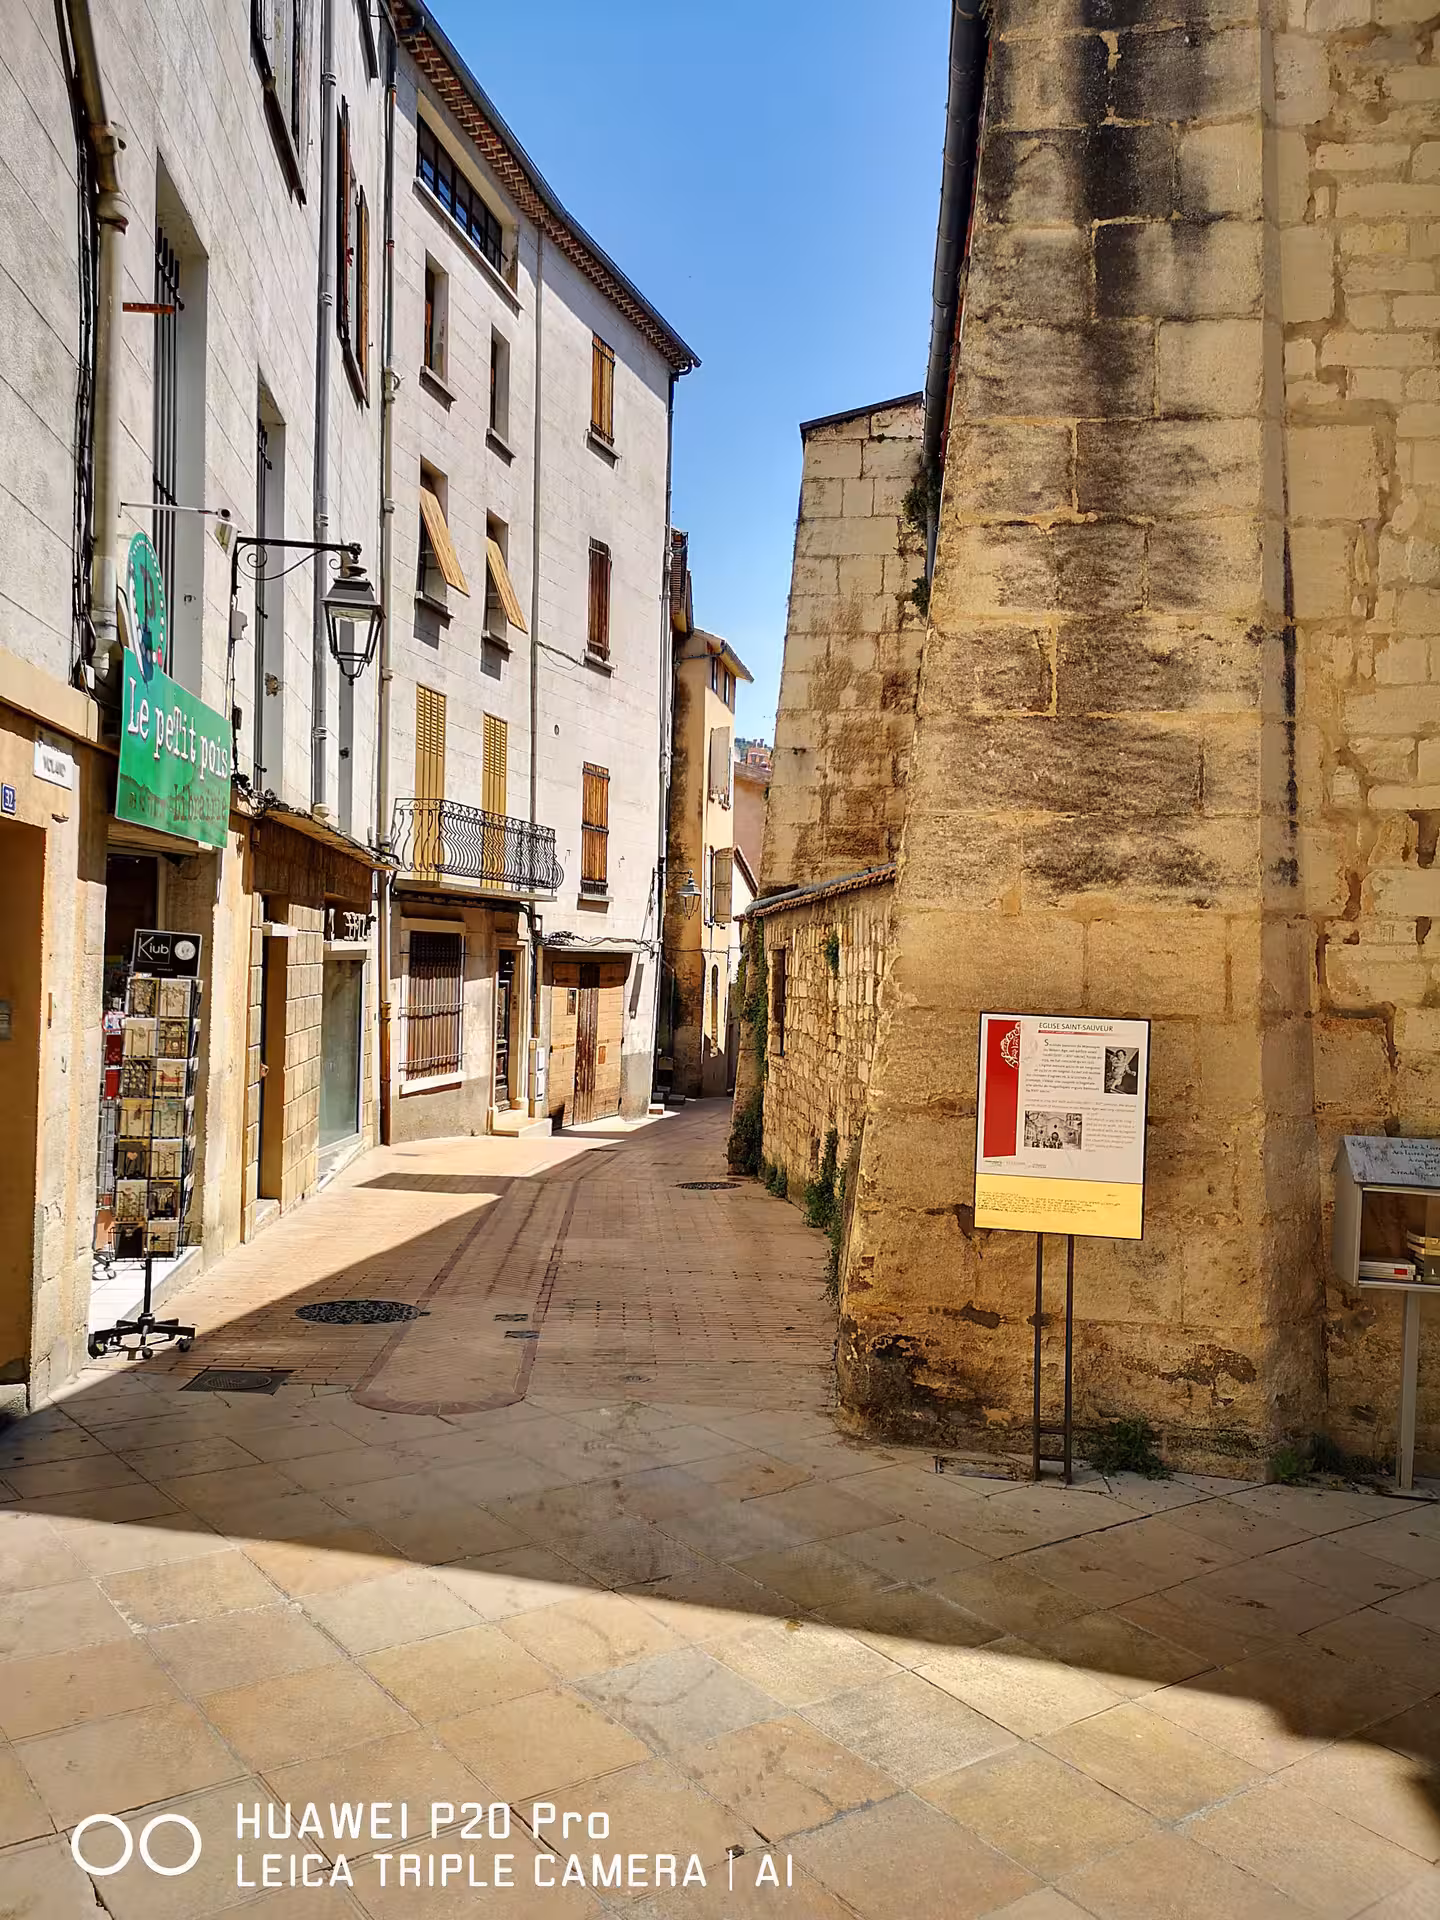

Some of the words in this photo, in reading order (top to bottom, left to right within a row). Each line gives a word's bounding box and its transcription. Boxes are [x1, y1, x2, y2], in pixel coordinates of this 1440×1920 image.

[127, 676, 149, 740] Le
[199, 735, 228, 781] pois
[137, 936, 169, 961] Kiub
[1062, 1023, 1114, 1032] SAINT-SAUVEUR
